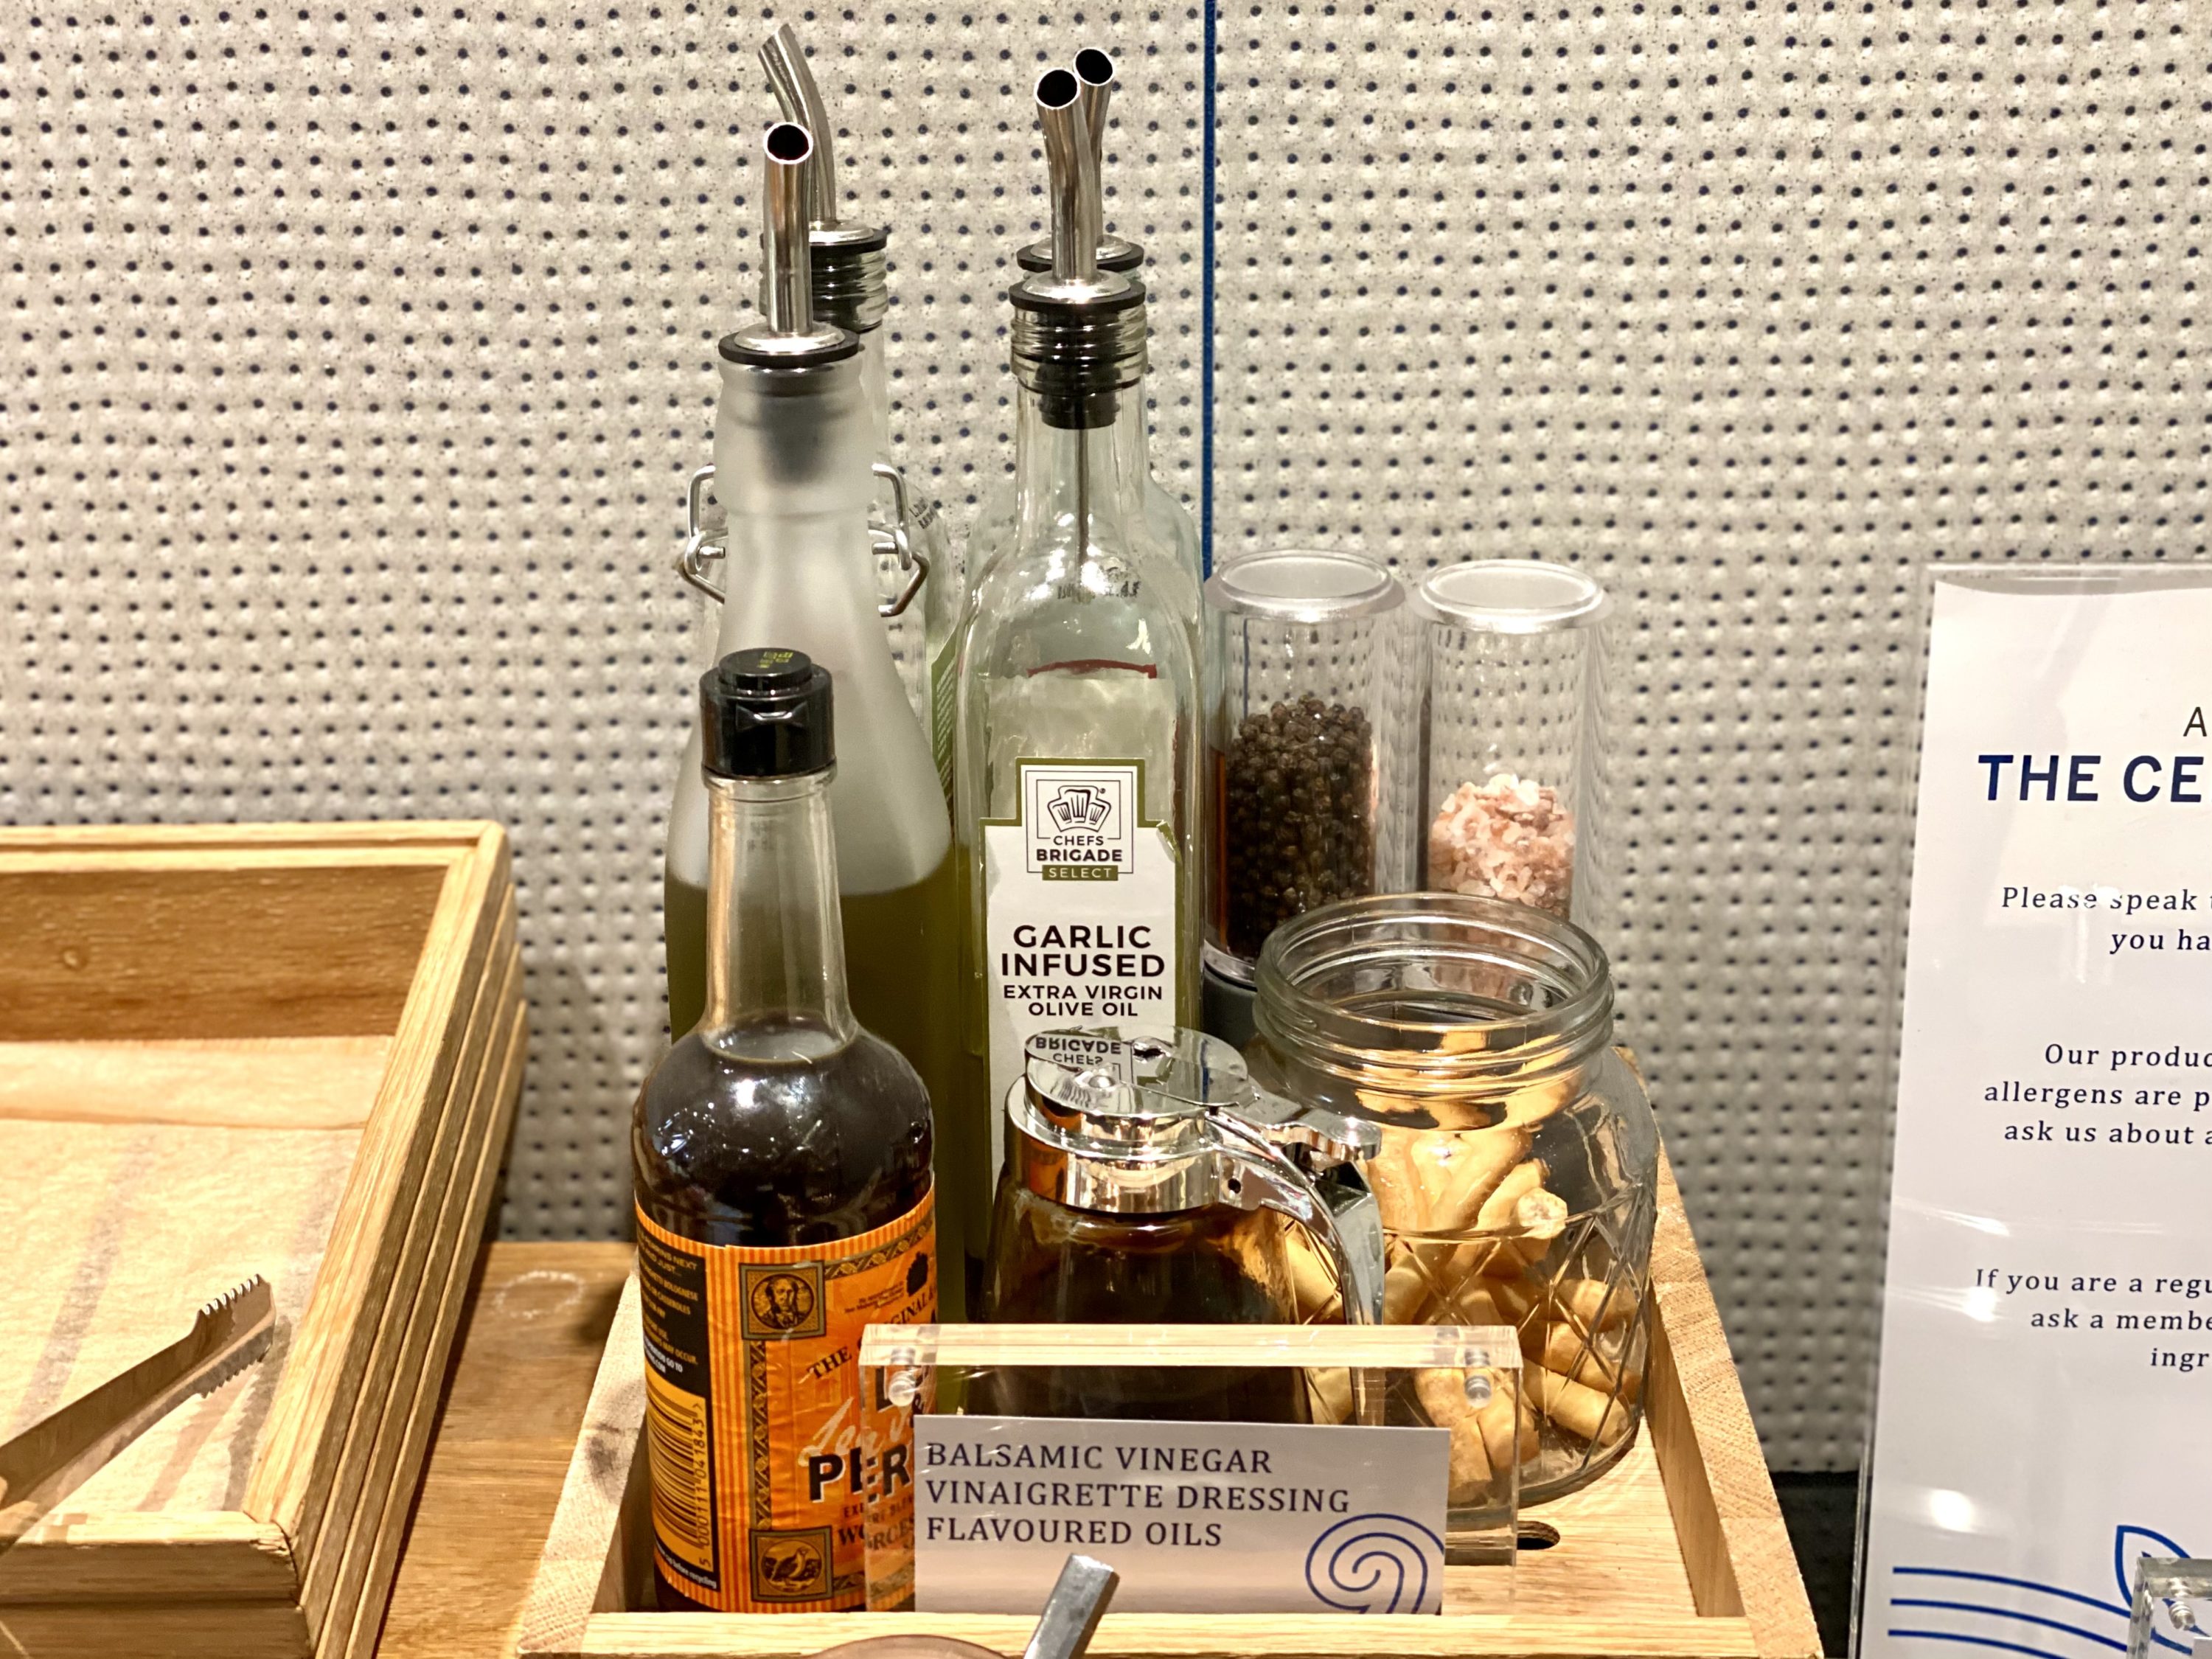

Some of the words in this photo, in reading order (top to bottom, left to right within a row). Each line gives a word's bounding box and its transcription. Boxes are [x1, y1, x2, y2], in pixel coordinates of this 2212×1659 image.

[2183, 706, 2208, 737] A
[1978, 754, 2101, 801] THE
[2123, 755, 2205, 803] CE
[1053, 835, 1105, 846] CHEFS
[1036, 849, 1122, 862] BRIGADE
[1048, 867, 1112, 879] SELECT
[2002, 886, 2097, 909] Please
[2110, 888, 2197, 916] speak
[1013, 925, 1151, 949] GARLIC
[2110, 933, 2164, 955] you
[2177, 928, 2211, 950] ha
[1001, 953, 1165, 978] INFUSED
[1004, 984, 1074, 999] EXTRA
[1085, 985, 1162, 1000] VIRGIN
[1028, 1002, 1093, 1017] OLIVE
[1102, 1002, 1138, 1017] OIL
[2045, 1043, 2099, 1065] Our
[2110, 1046, 2212, 1071] produc
[1984, 1081, 2123, 1109] allergens
[2135, 1090, 2181, 1106] are
[2193, 1091, 2210, 1112] p
[2004, 1120, 2053, 1141] ask
[2065, 1127, 2096, 1142] us
[2109, 1122, 2194, 1144] about
[1977, 1268, 1999, 1288] If
[2006, 1275, 2059, 1295] you
[2071, 1277, 2117, 1292] are
[2129, 1278, 2142, 1293] a
[2031, 1307, 2079, 1328] ask
[2090, 1314, 2104, 1329] a
[807, 1346, 852, 1379] THE
[2151, 1347, 2210, 1373] ingr
[927, 1442, 1102, 1470] BALSAMIC
[1115, 1447, 1272, 1474] VINEGAR
[925, 1480, 1163, 1509] VINAIGRETTE
[1177, 1486, 1349, 1513] DRESSING
[927, 1517, 1132, 1544] FLAVOURED
[1145, 1522, 1221, 1547] OILS
[698, 1557, 712, 1568] 5
